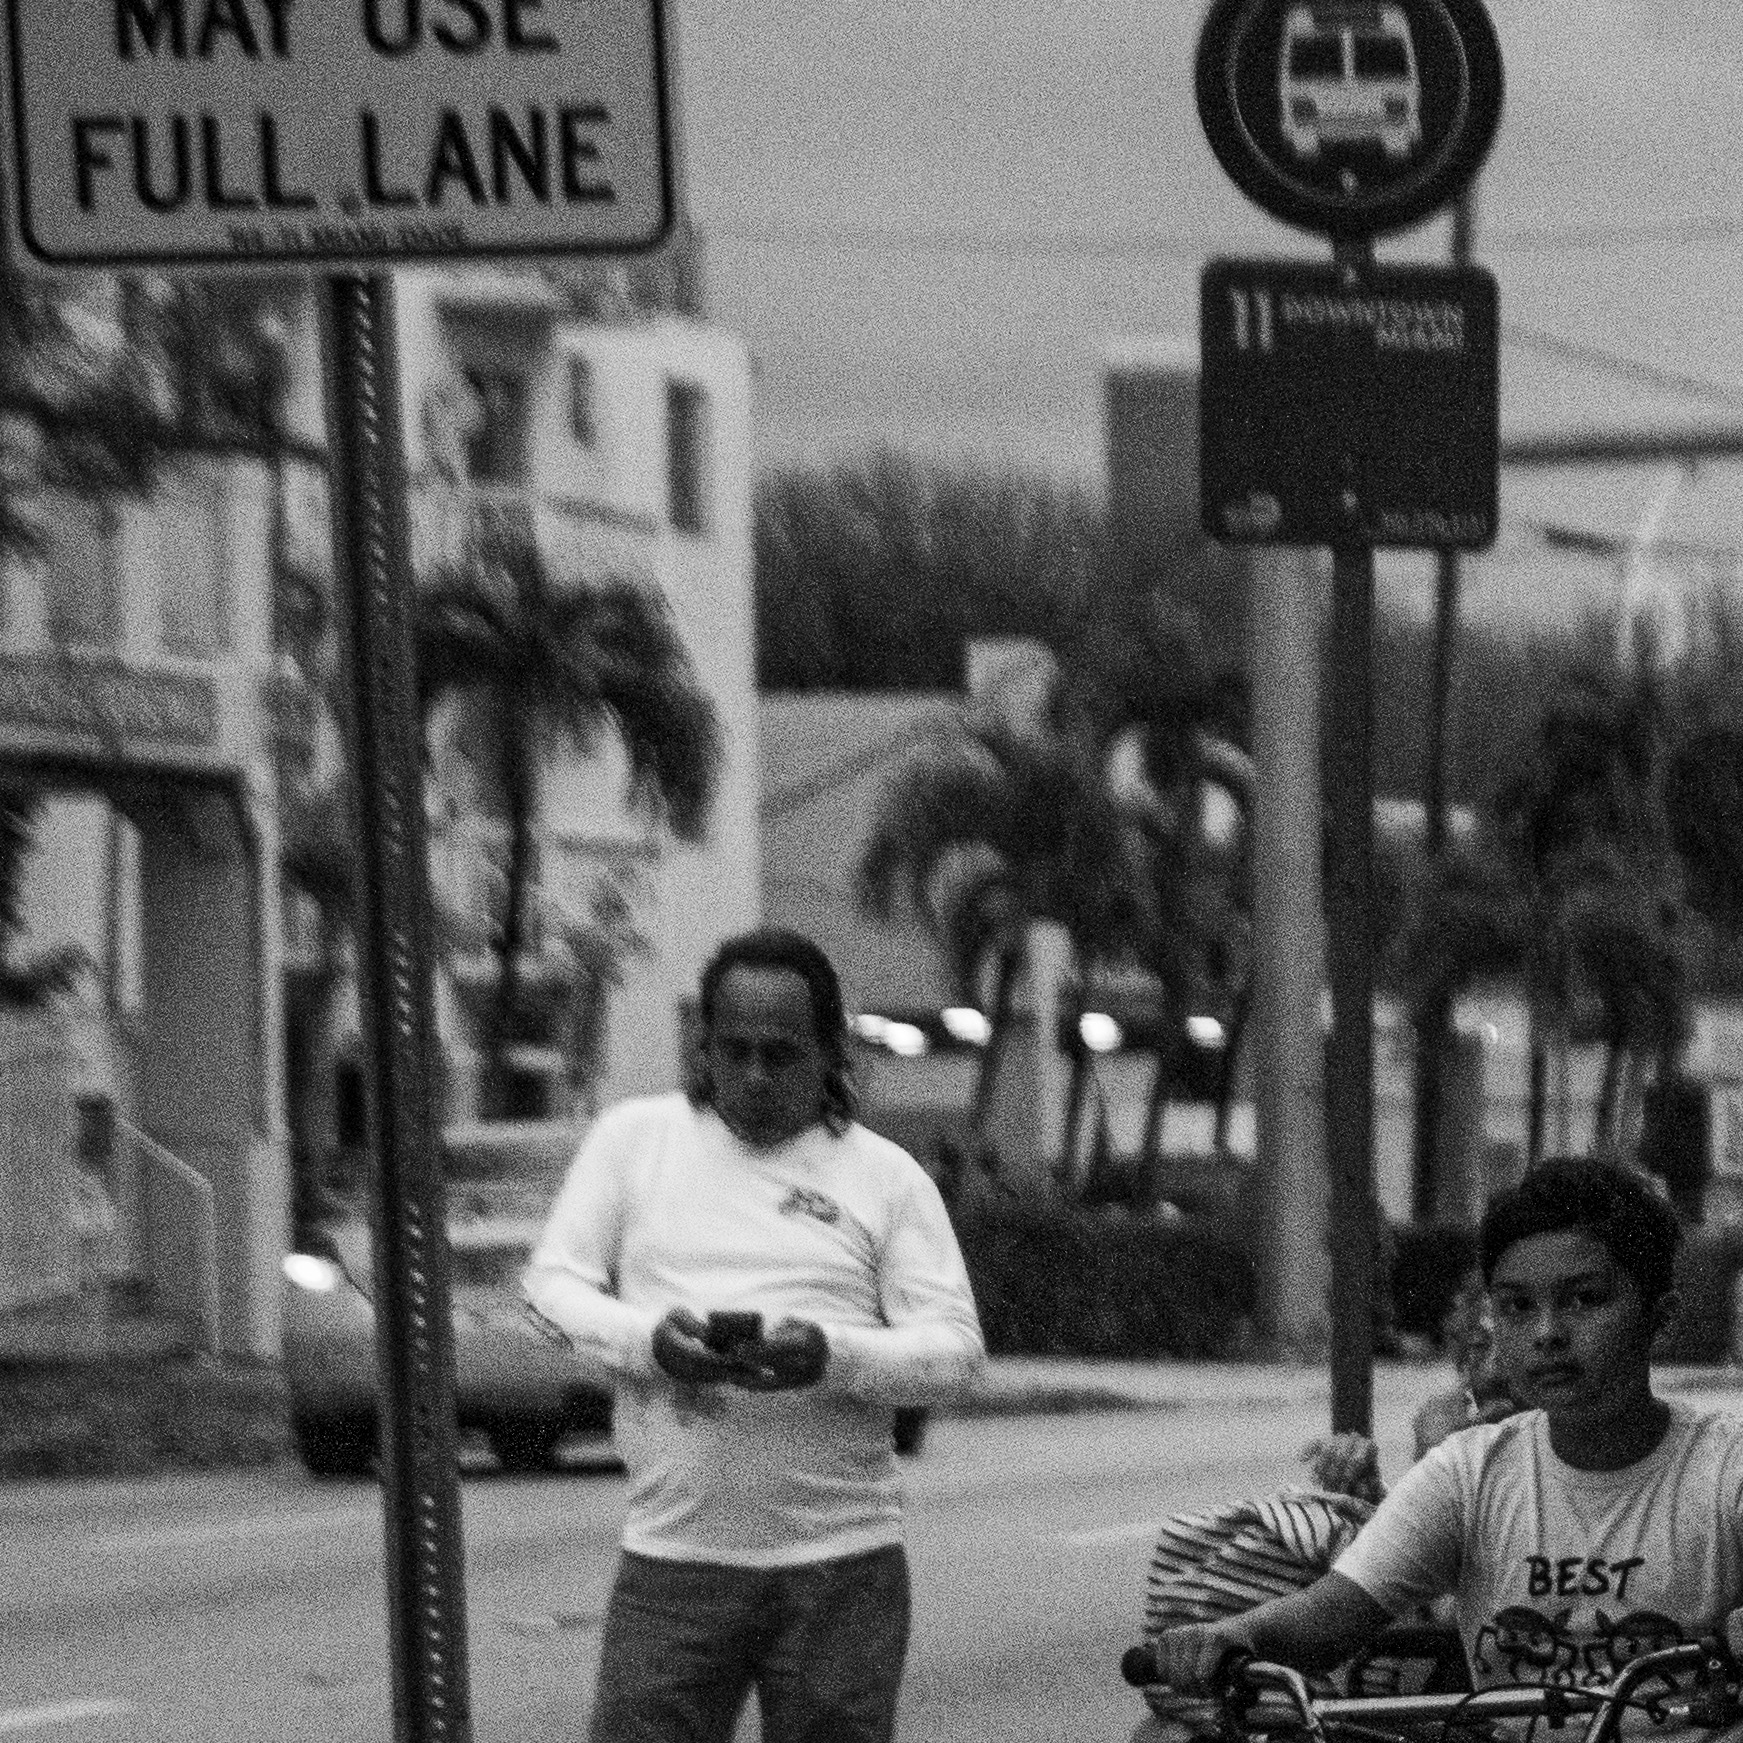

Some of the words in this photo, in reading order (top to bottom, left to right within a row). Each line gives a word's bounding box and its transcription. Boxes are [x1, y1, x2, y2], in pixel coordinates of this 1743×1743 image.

[113, 0, 290, 58] MAY
[363, 0, 561, 57] USE
[72, 114, 318, 210] FULL
[361, 109, 618, 206] LANE
[1229, 287, 1273, 352] 11
[1525, 1555, 1646, 1600] BEST
